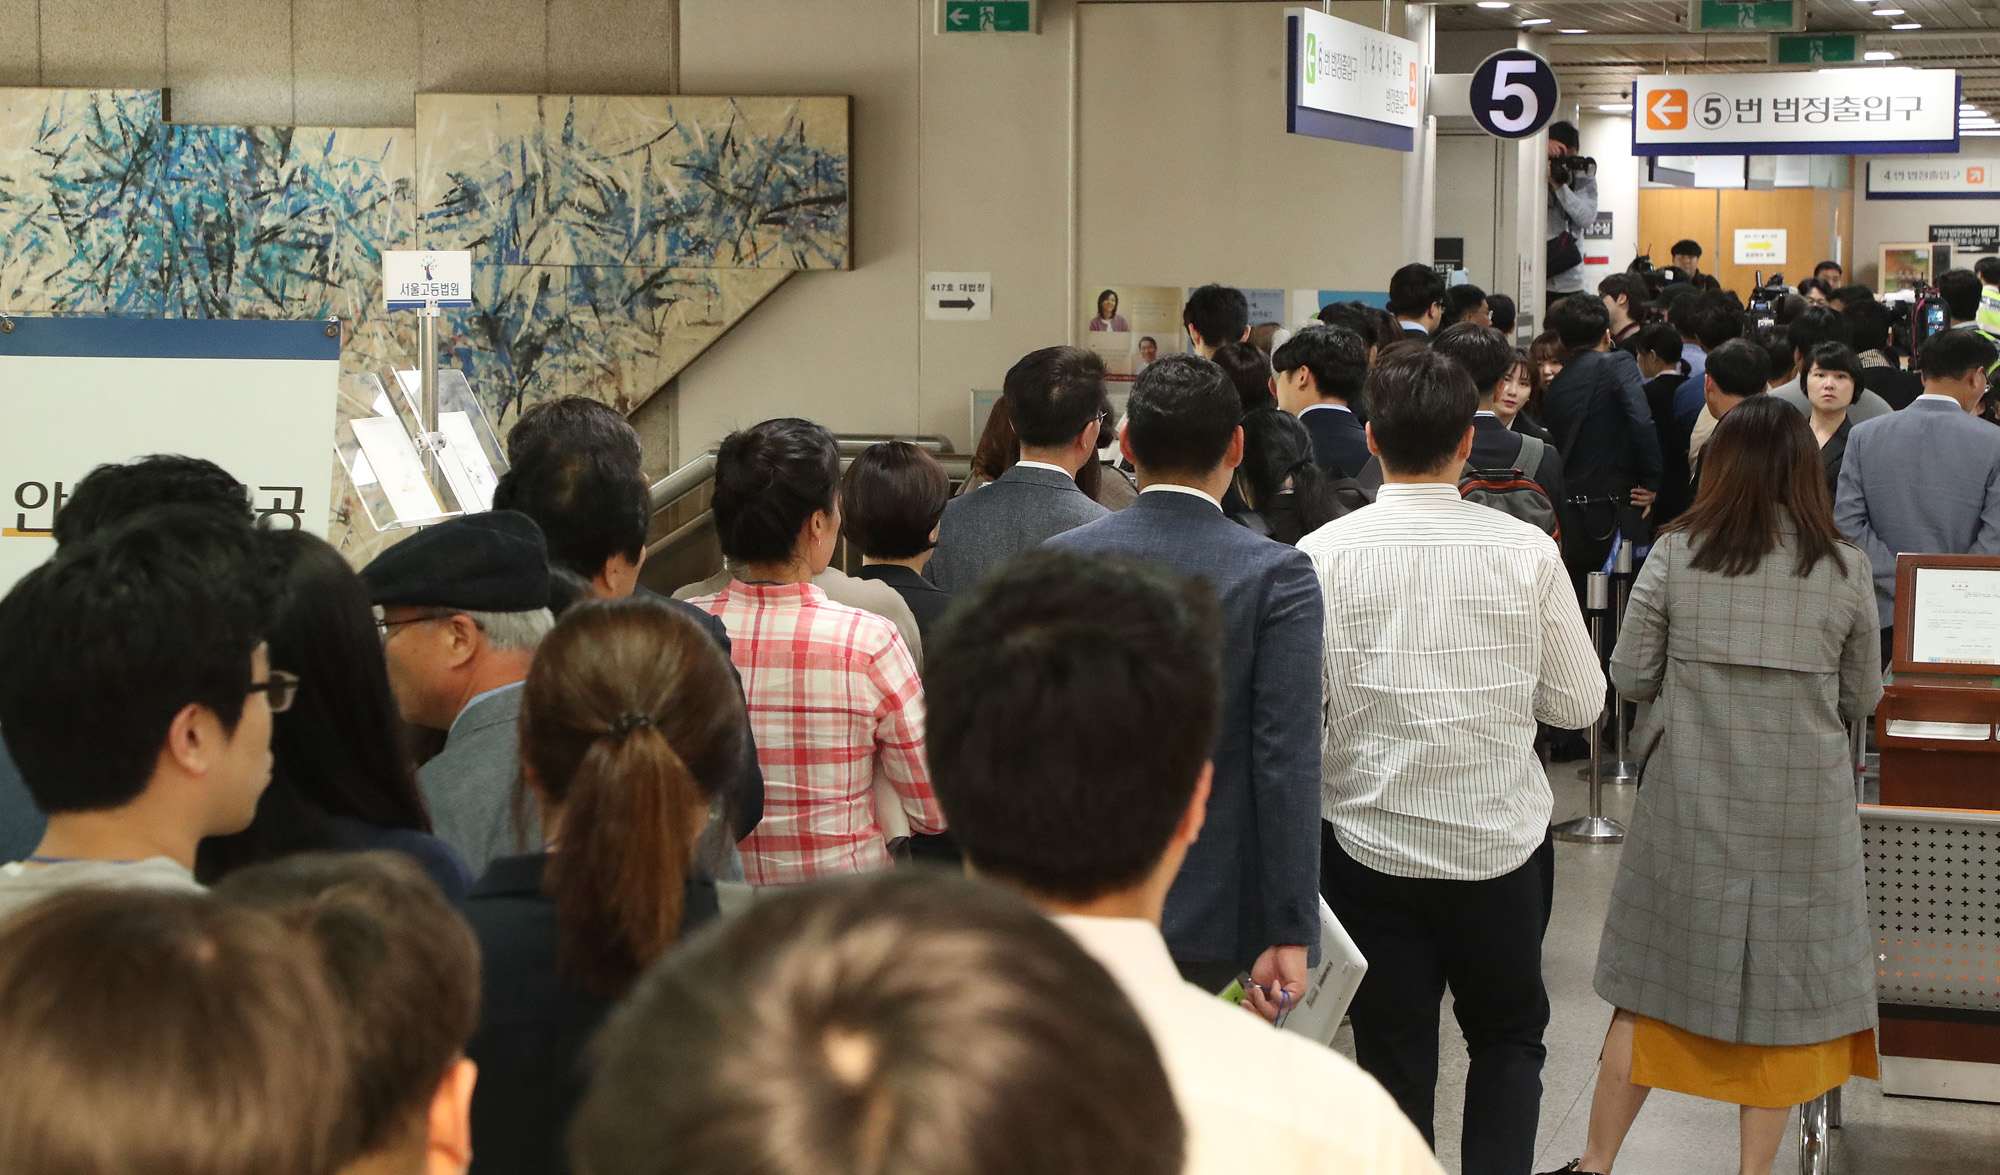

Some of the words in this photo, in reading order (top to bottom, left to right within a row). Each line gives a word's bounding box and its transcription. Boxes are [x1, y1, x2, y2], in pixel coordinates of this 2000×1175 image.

[1331, 50, 1358, 82] 법정출입구
[1489, 60, 1539, 132] 5
[1773, 96, 1923, 124] 법정출입구
[400, 282, 459, 296] 서울고등법원
[931, 283, 954, 292] 417호
[959, 283, 985, 292] 대법정
